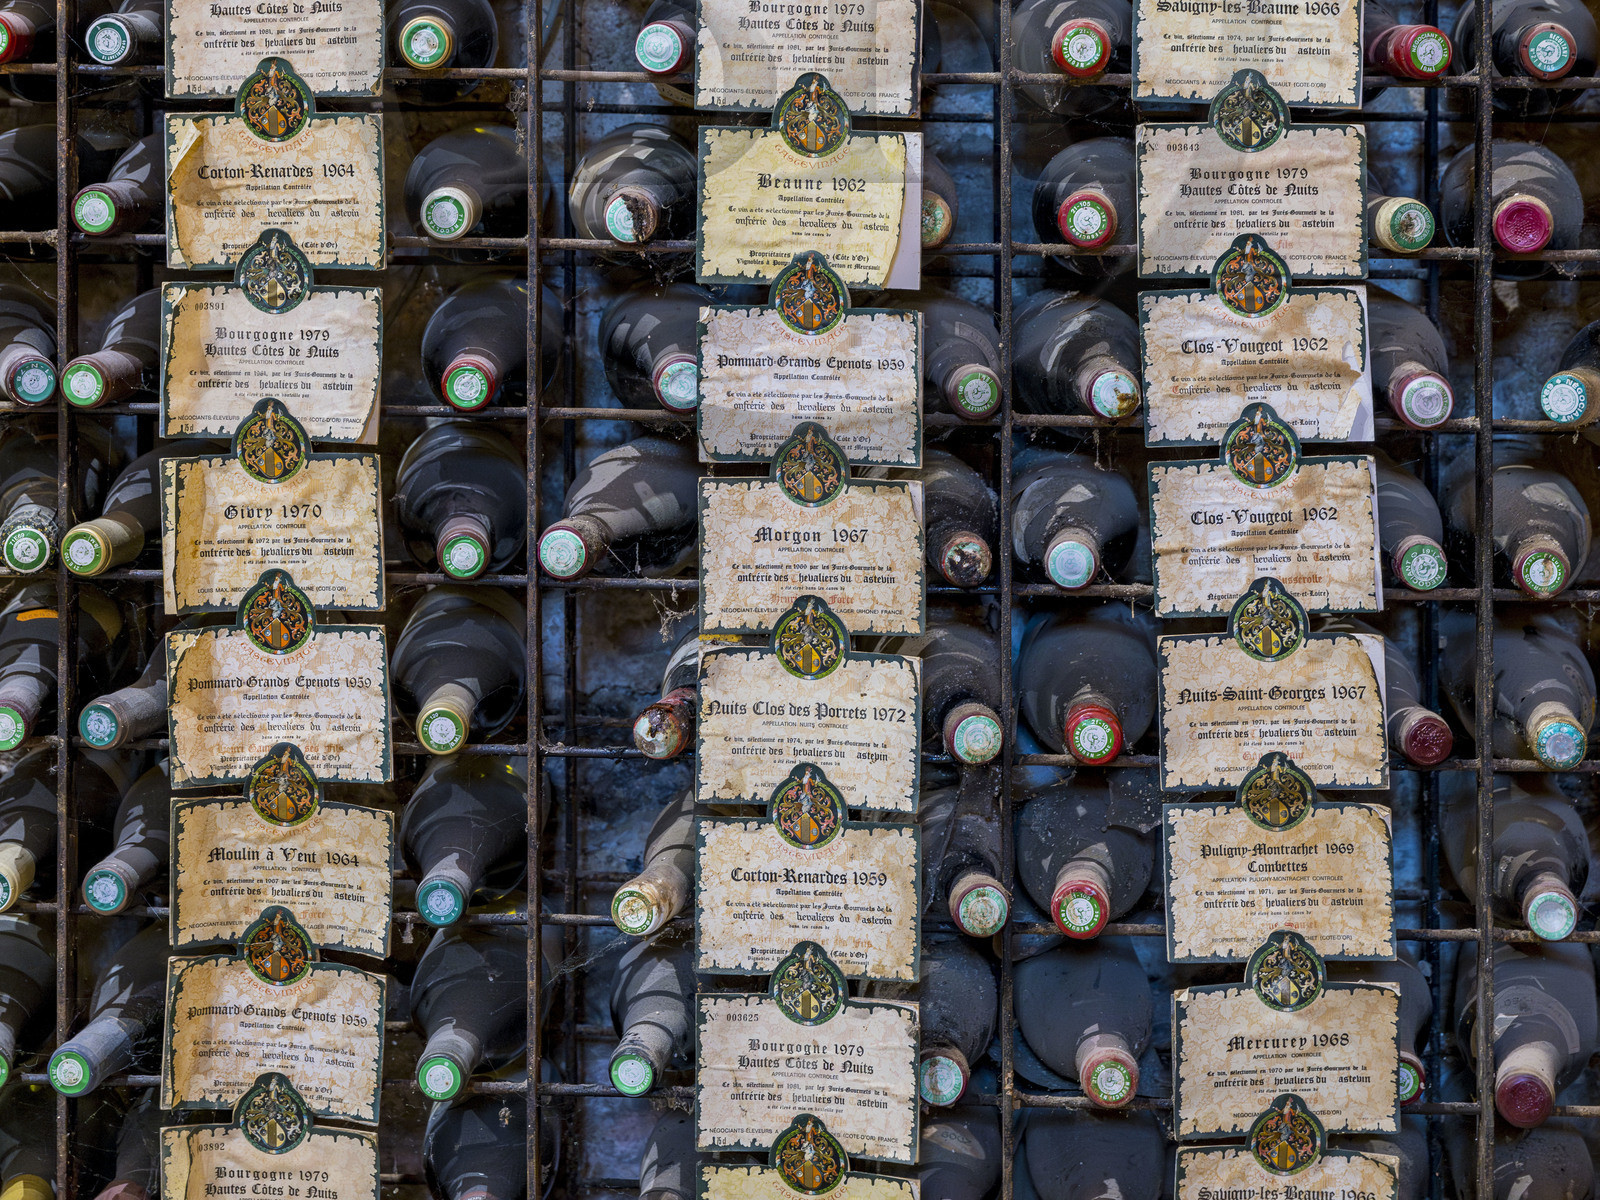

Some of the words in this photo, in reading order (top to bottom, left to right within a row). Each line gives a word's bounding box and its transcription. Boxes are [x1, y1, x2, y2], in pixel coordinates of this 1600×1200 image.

[210, 4, 251, 18] Hautes
[257, 3, 288, 14] Côtes
[293, 3, 304, 13] de
[310, 1, 342, 14] Nuits
[749, 0, 827, 16] Bourgogne
[835, 4, 864, 15] 1979
[1305, 2, 1340, 15] 1966
[738, 17, 780, 31] Hautes
[786, 18, 818, 30] Côtes
[824, 20, 834, 31] de
[840, 20, 874, 32] Nuits
[198, 164, 313, 179] Corton-Renardes
[323, 164, 354, 177] 1964
[1190, 168, 1269, 181] Bourgogne
[1277, 168, 1308, 179] 1979
[758, 173, 822, 190] Beaune
[832, 178, 865, 192] 1962
[1180, 184, 1222, 198] Hautes
[1228, 184, 1260, 195] Côtes
[1266, 184, 1277, 195] de
[1284, 183, 1318, 196] Nuits
[216, 327, 293, 342] Bourgogne
[300, 330, 329, 341] 1979
[205, 343, 246, 357] Hautes
[252, 345, 284, 356] Côtes
[289, 346, 300, 356] de
[306, 345, 339, 358] Nuits
[1293, 337, 1328, 351] 1962
[878, 359, 904, 370] 1959
[1216, 385, 1230, 393] des
[1287, 382, 1298, 390] du
[224, 505, 272, 521] Givry
[282, 504, 321, 518] 1970
[1302, 507, 1337, 521] 1962
[753, 527, 820, 544] Morgon
[833, 529, 868, 543] 1967
[346, 677, 371, 689] 1959
[1332, 686, 1366, 699] 1967
[704, 700, 747, 716] Nuits
[753, 701, 785, 715] Clos
[789, 703, 810, 716] des
[815, 703, 867, 720] Porrets
[873, 708, 906, 723] 1972
[207, 847, 259, 863] Moulin
[267, 848, 273, 860] à
[280, 848, 316, 863] Vent
[326, 852, 359, 867] 1964
[1200, 843, 1318, 859] Puligny-Montrachet
[1326, 843, 1354, 854] 1969
[1248, 861, 1307, 872] Combettes
[731, 867, 847, 884] Corton-Renardes
[853, 872, 887, 886] 1959
[342, 1014, 367, 1027] 1959
[749, 1039, 827, 1055] Bourgogne
[835, 1044, 864, 1056] 1979
[1226, 1036, 1307, 1052] Mercurey
[1313, 1033, 1349, 1047] 1968
[738, 1055, 780, 1069] Hautes
[786, 1057, 818, 1069] Côtes
[823, 1059, 834, 1071] de
[840, 1060, 873, 1074] Nuits
[215, 1167, 292, 1181] Bourgogne
[300, 1171, 328, 1182] 1979
[205, 1183, 246, 1197] Hautes
[252, 1184, 283, 1196] Côtes
[289, 1185, 299, 1196] de
[305, 1186, 337, 1199] Nuits
